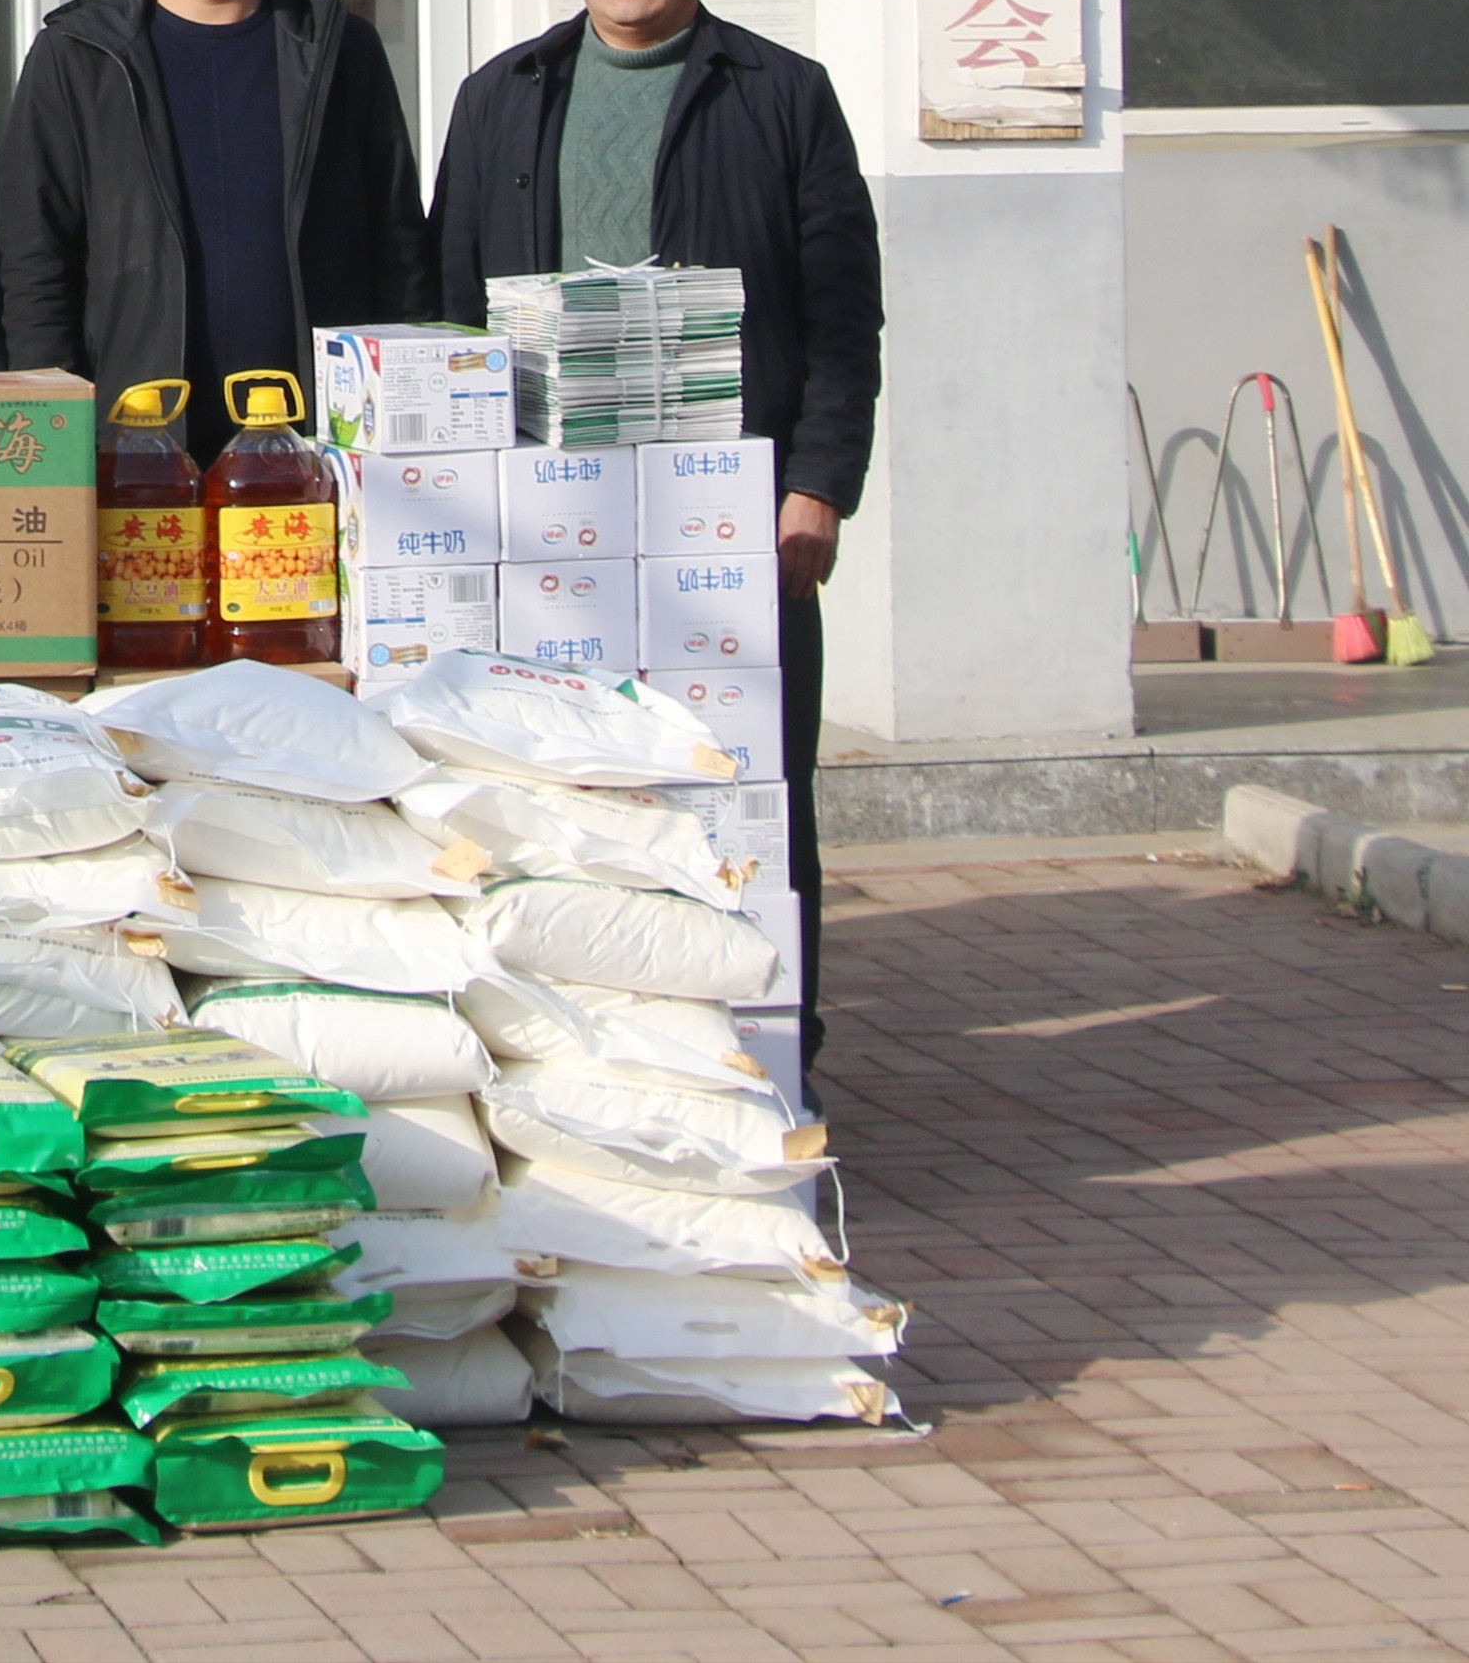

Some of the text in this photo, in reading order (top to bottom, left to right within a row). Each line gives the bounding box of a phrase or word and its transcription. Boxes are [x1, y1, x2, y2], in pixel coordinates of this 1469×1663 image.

[537, 458, 603, 482] 纯牛奶
[673, 452, 741, 476] 纯牛奶
[398, 530, 466, 552] 纯牛奶
[14, 547, 46, 569] Oil
[677, 567, 744, 592] 纯牛奶
[536, 637, 605, 660] 纯牛奶
